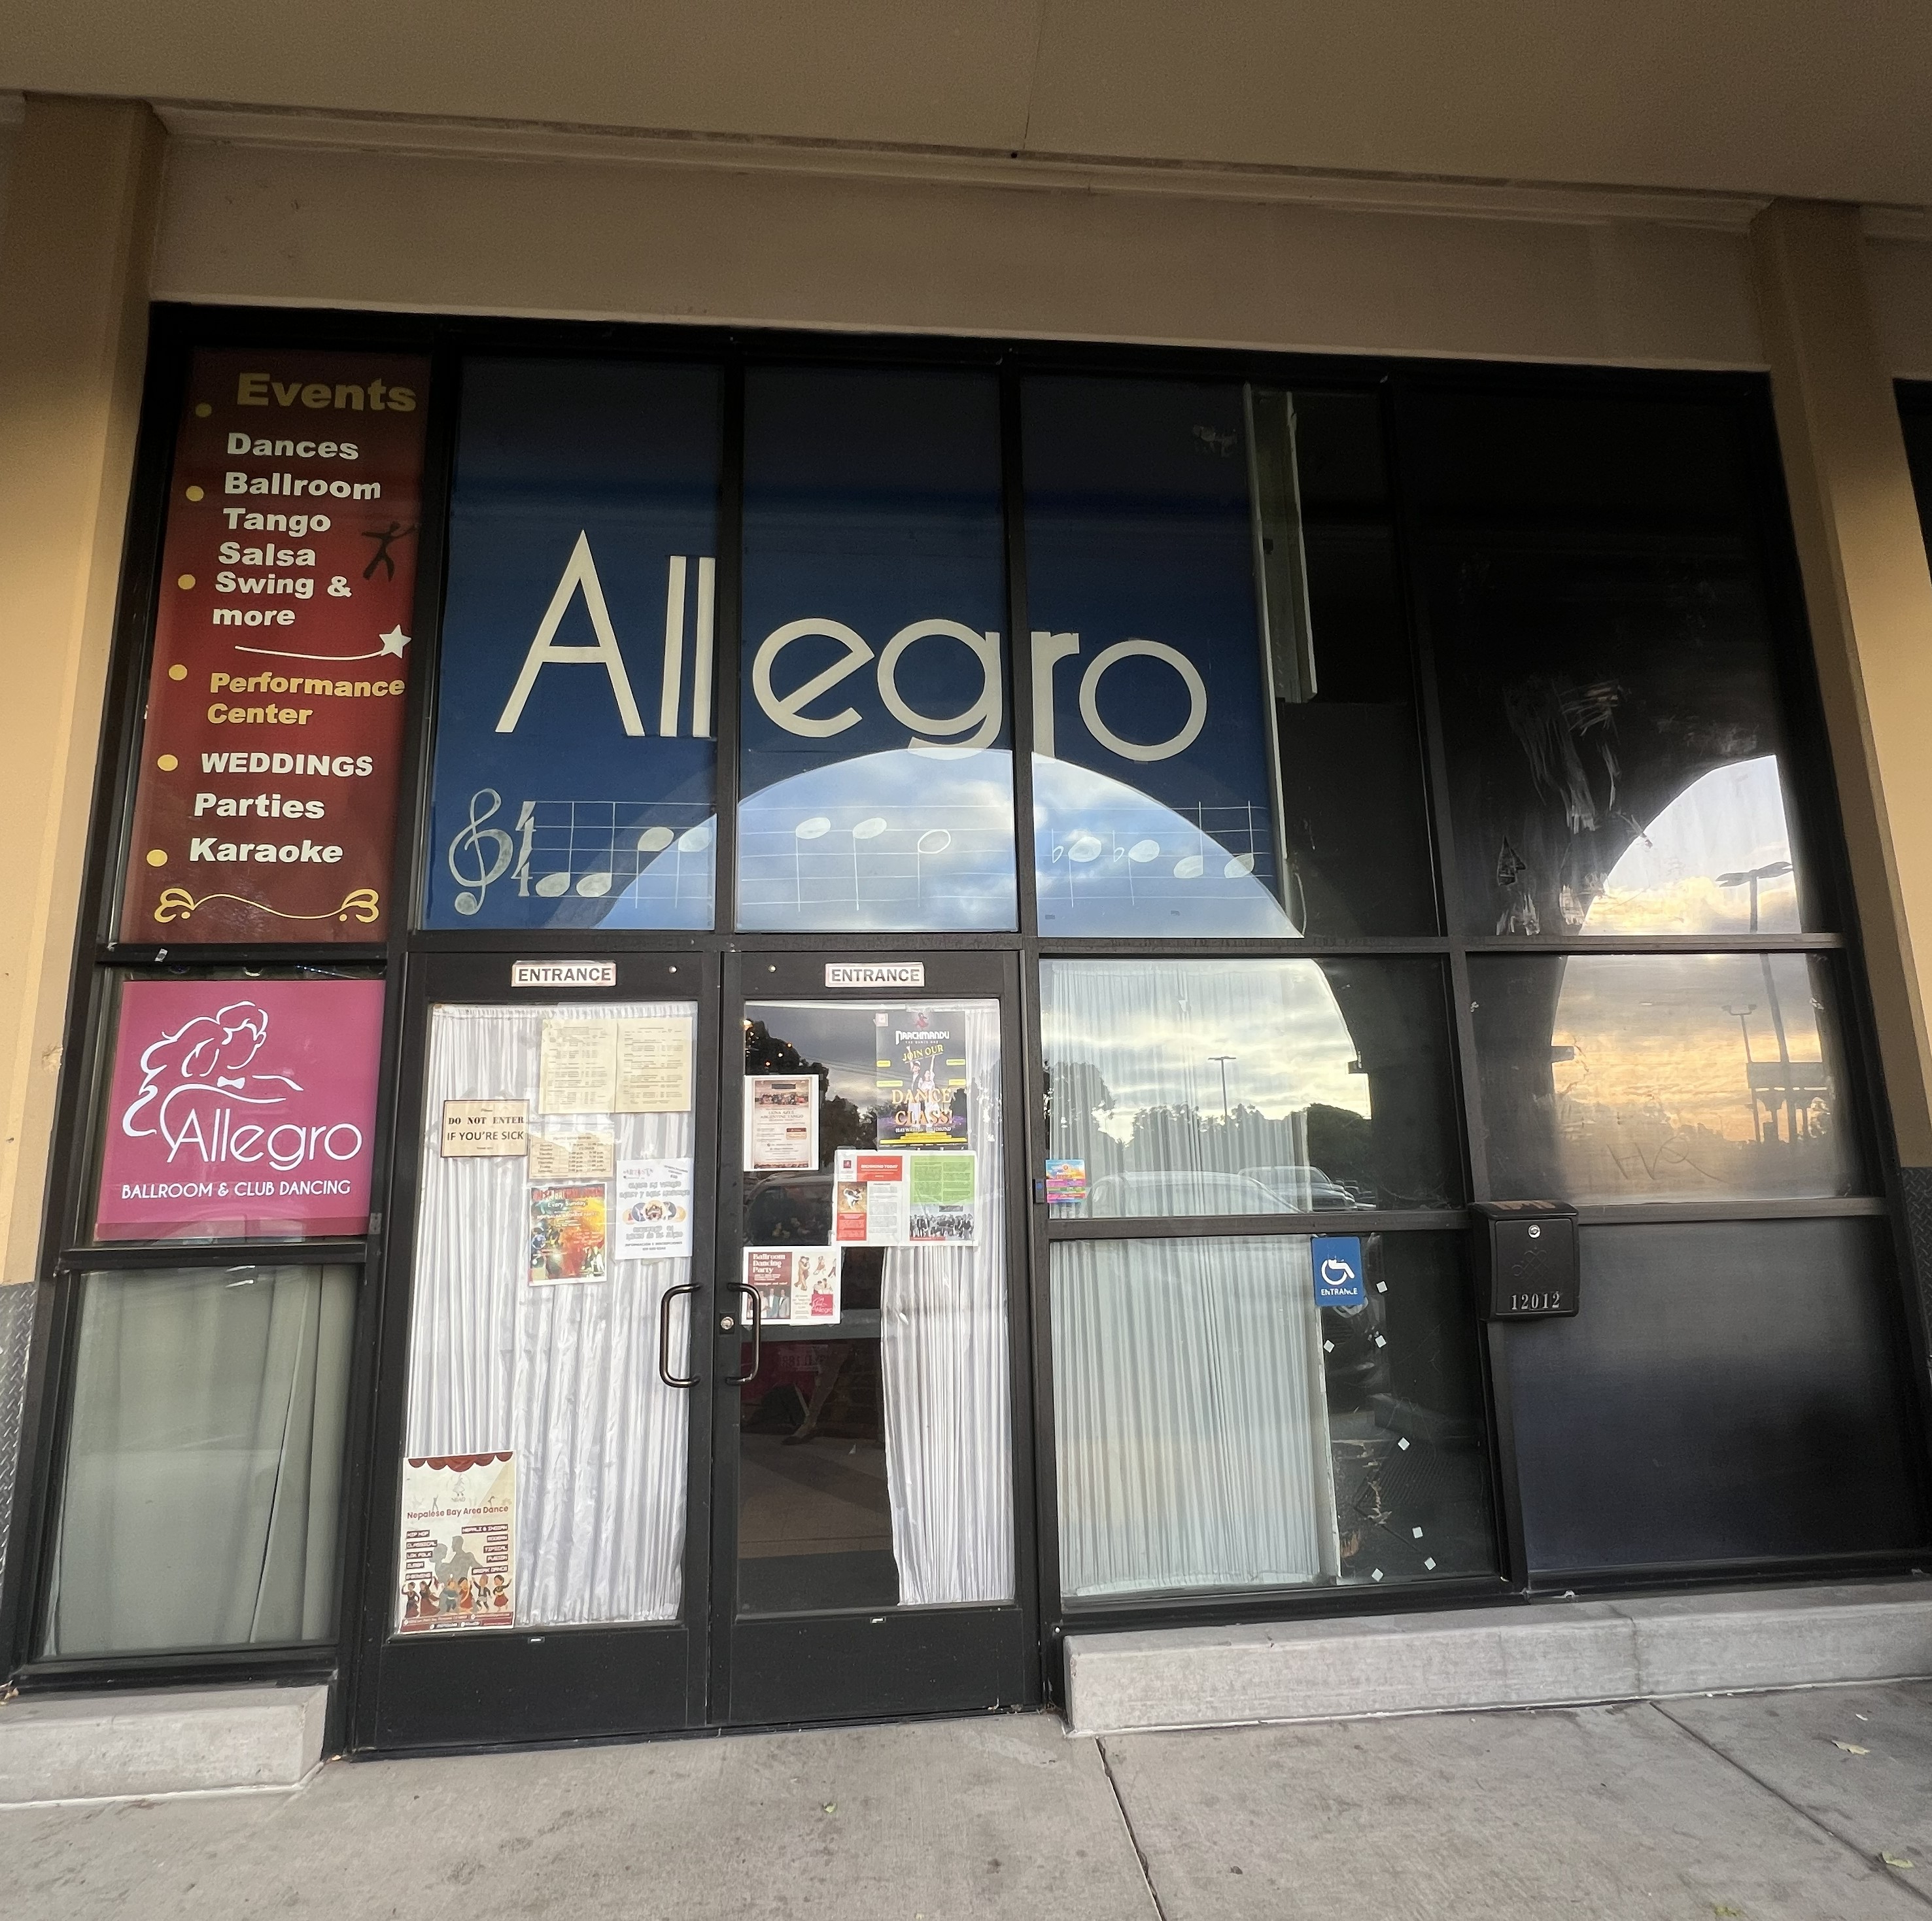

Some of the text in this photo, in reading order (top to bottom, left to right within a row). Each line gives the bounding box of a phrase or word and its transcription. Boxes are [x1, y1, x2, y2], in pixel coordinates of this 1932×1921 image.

[237, 372, 417, 412] Events
[227, 432, 359, 460] Dances
[224, 472, 381, 500] Ballroom
[223, 508, 331, 537] Tango
[218, 542, 316, 566] Salsa
[215, 571, 352, 599] Swing &
[212, 608, 296, 626] more
[495, 529, 1207, 763] Allegro
[210, 672, 405, 697] Performance
[207, 703, 313, 725] Center
[201, 752, 373, 776] WEDDINGS
[194, 793, 325, 819] Parties
[189, 838, 343, 863] Karaoke
[519, 968, 612, 982] ENTRANCE
[831, 969, 920, 982] ENTRANCE
[903, 1044, 944, 1062] JOIN OUR
[891, 1088, 952, 1104] DANCE
[167, 1108, 362, 1171] Allegro
[447, 1131, 524, 1141] IF YOU'RE SICK
[122, 1180, 351, 1199] BALLROOM & CLUB DANCING
[753, 1260, 782, 1269] Dancing
[1511, 1292, 1560, 1310] 12012
[446, 1508, 462, 1517] Bay
[463, 1507, 481, 1515] Area
[483, 1505, 509, 1514] Dance
